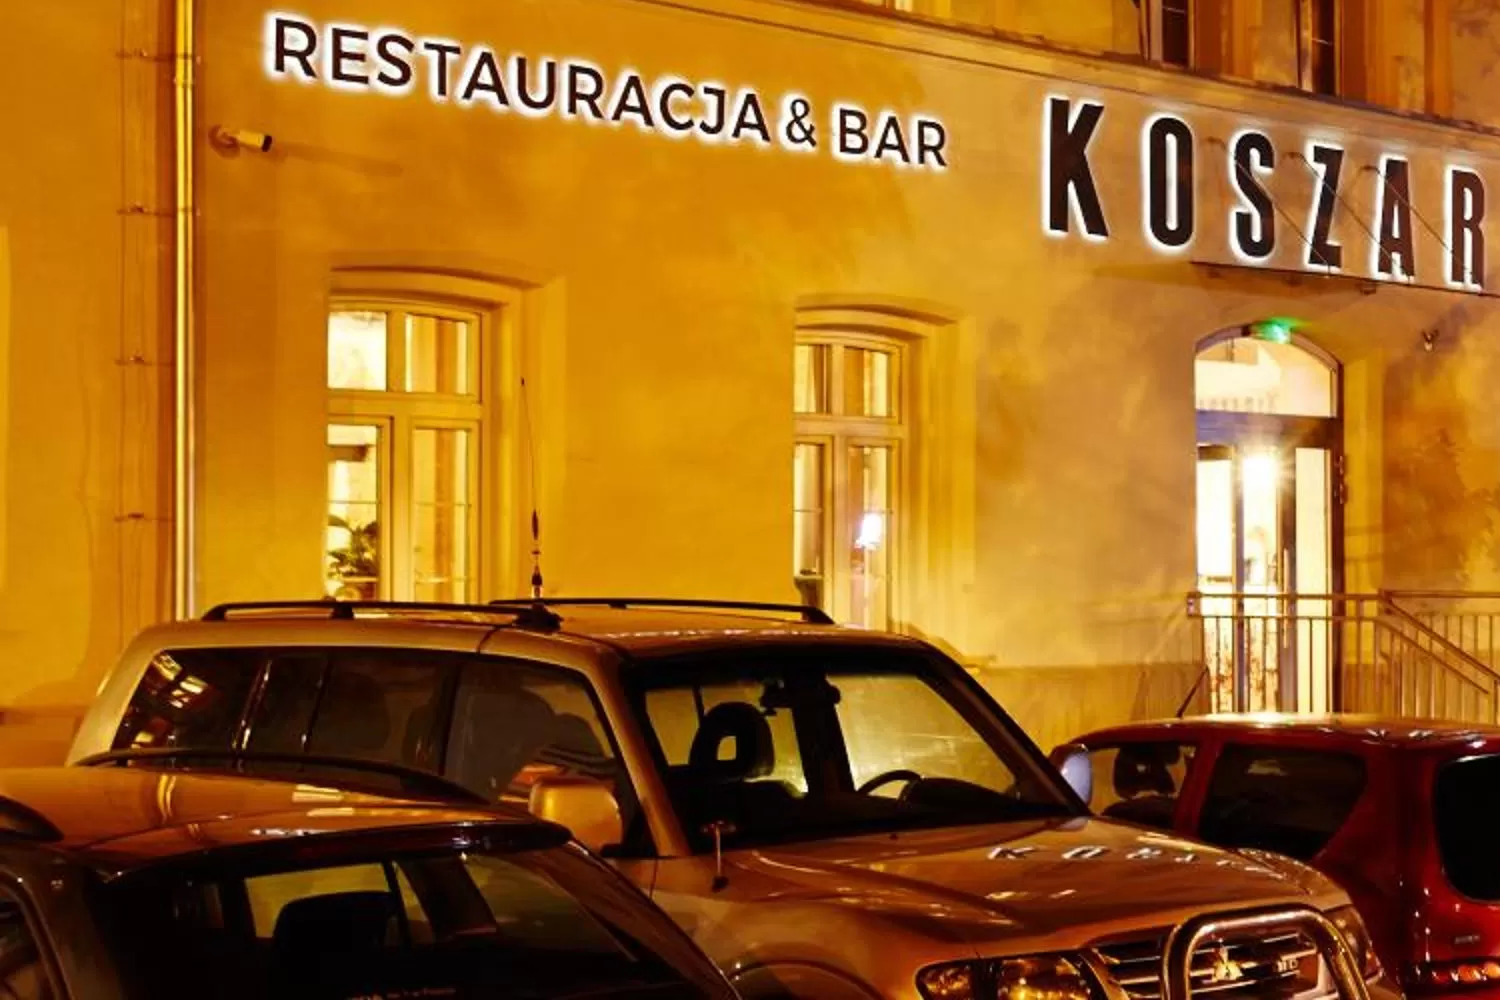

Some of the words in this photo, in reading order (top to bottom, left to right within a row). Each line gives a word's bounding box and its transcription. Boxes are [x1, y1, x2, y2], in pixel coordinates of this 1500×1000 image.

[273, 18, 771, 142] RESTAURACJA
[786, 98, 818, 147] &
[839, 108, 948, 167] BAR
